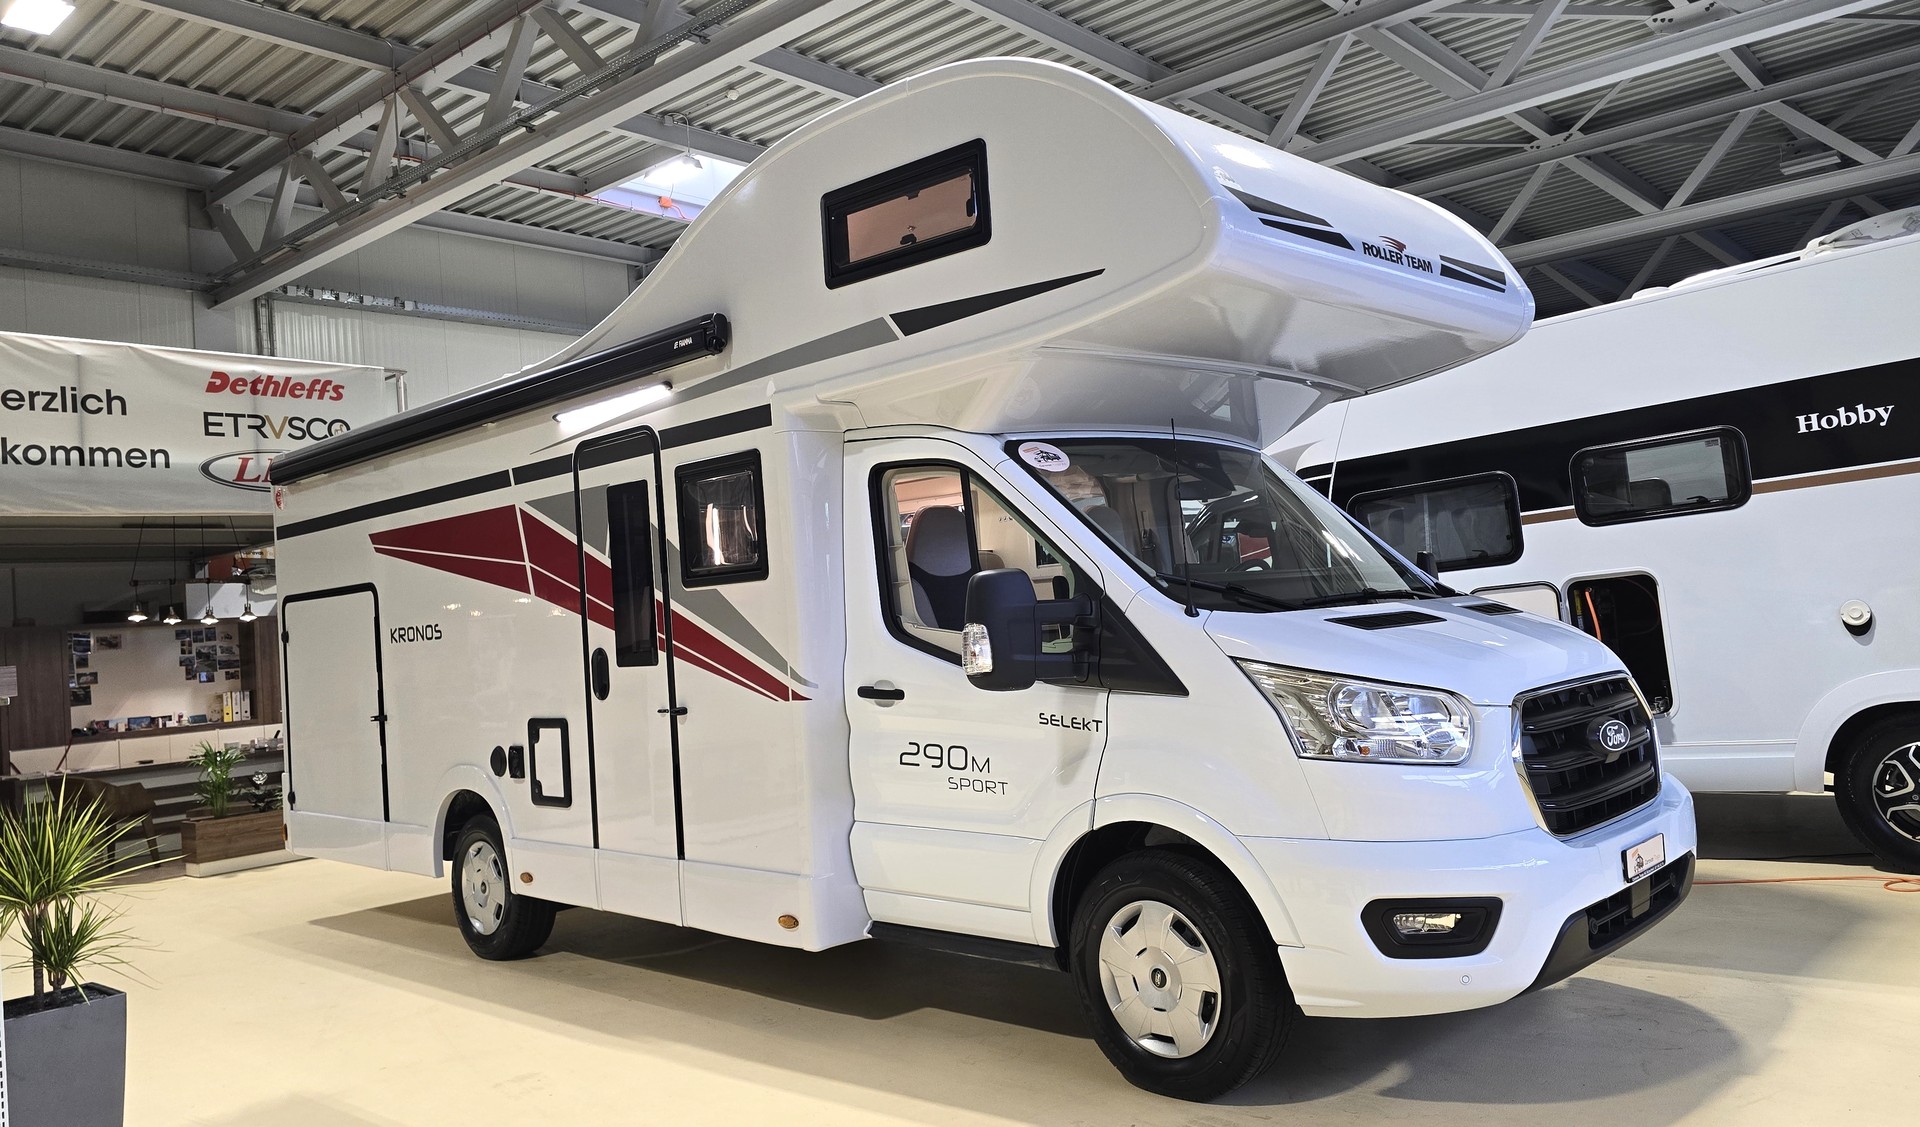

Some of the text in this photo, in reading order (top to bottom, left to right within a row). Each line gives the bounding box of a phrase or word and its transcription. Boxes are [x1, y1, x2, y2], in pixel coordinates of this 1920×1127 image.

[1362, 241, 1433, 274] ROLLER TEAM
[0, 386, 127, 415] erzlich
[205, 371, 345, 402] Dethleffs
[1795, 403, 1895, 434] Hobby
[0, 436, 170, 469] kommen
[390, 623, 442, 644] KRONOS
[1606, 725, 1626, 746] Ford
[948, 776, 1008, 796] SPORT
